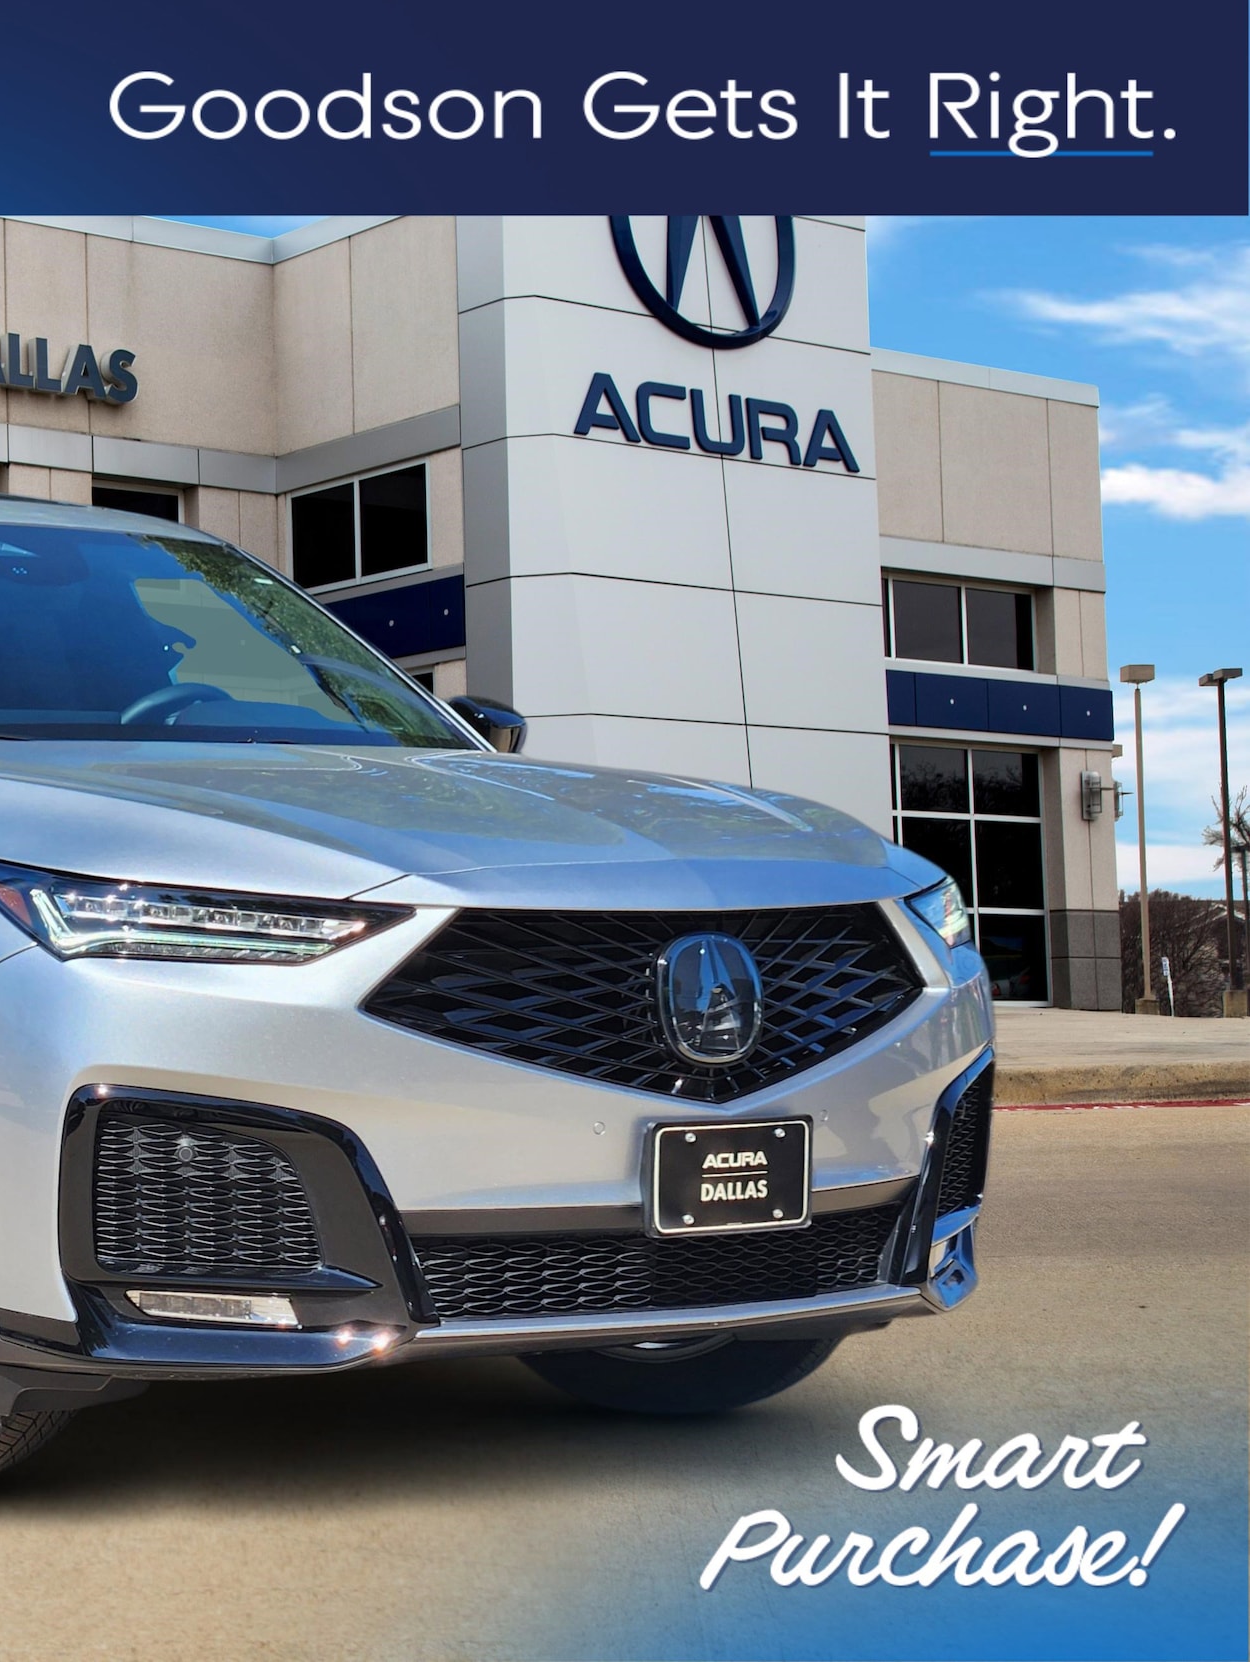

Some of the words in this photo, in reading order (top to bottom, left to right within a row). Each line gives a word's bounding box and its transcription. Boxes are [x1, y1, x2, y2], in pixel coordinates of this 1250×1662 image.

[573, 372, 860, 472] ACURA
[702, 1150, 768, 1169] ACURA
[701, 1179, 768, 1202] DALLAS
